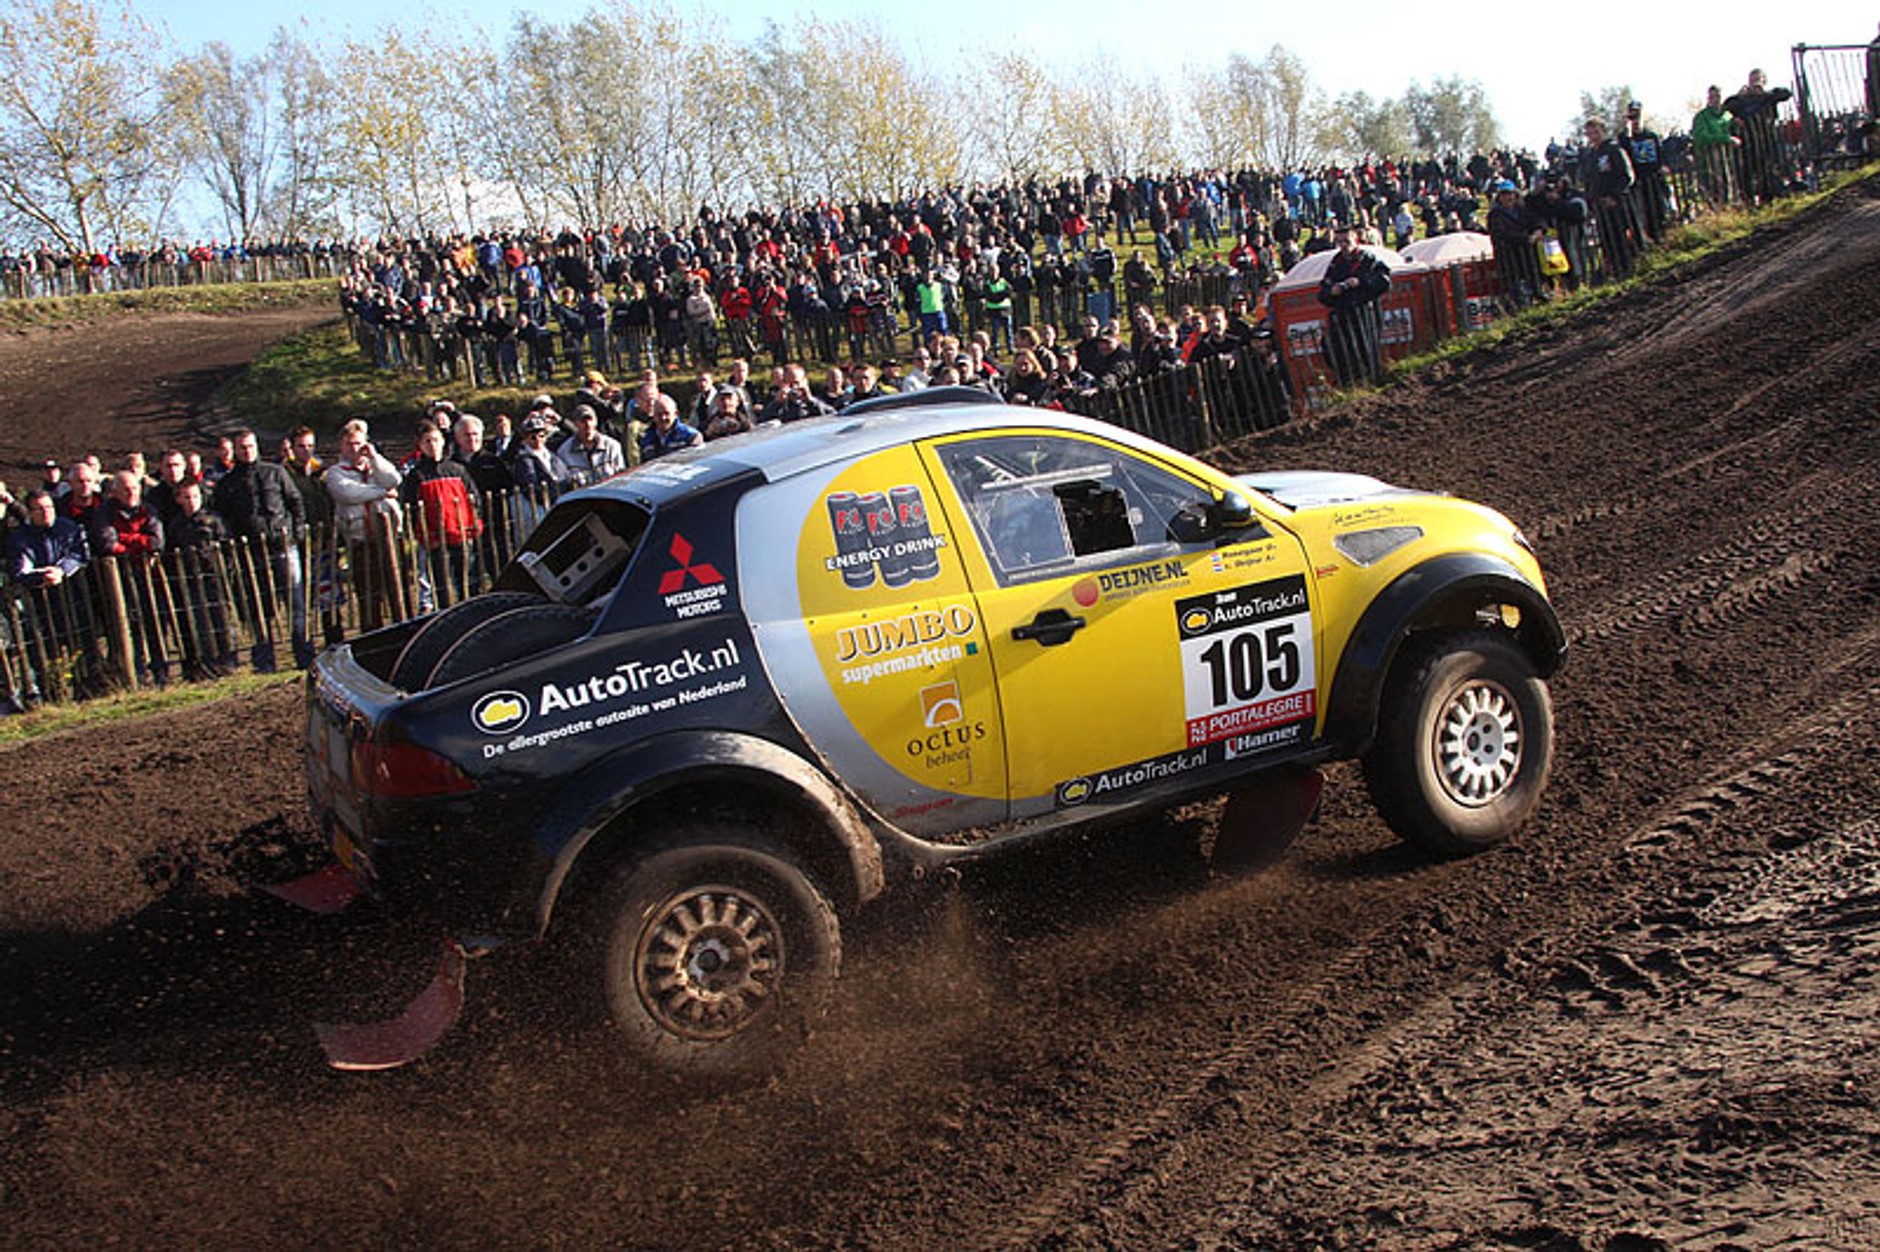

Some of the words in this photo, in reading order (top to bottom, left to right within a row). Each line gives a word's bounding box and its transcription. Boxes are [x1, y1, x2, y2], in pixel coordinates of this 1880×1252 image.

[826, 545, 890, 570] ENERGY
[894, 534, 947, 556] DRINK
[1098, 560, 1188, 592] DEIJNE.NL
[676, 599, 722, 619] MOTORS
[1213, 588, 1305, 624] AutoTrack.nl
[836, 604, 976, 663] JUMBO
[539, 639, 740, 716] AutoTrack.nl
[841, 644, 963, 685] supermarkten
[1200, 622, 1300, 708] 105
[483, 743, 505, 759] De
[651, 696, 676, 712] van
[679, 676, 747, 705] Nederland
[1210, 695, 1303, 732] PORTALEGRE
[1096, 750, 1207, 794] AutoTrack.nl
